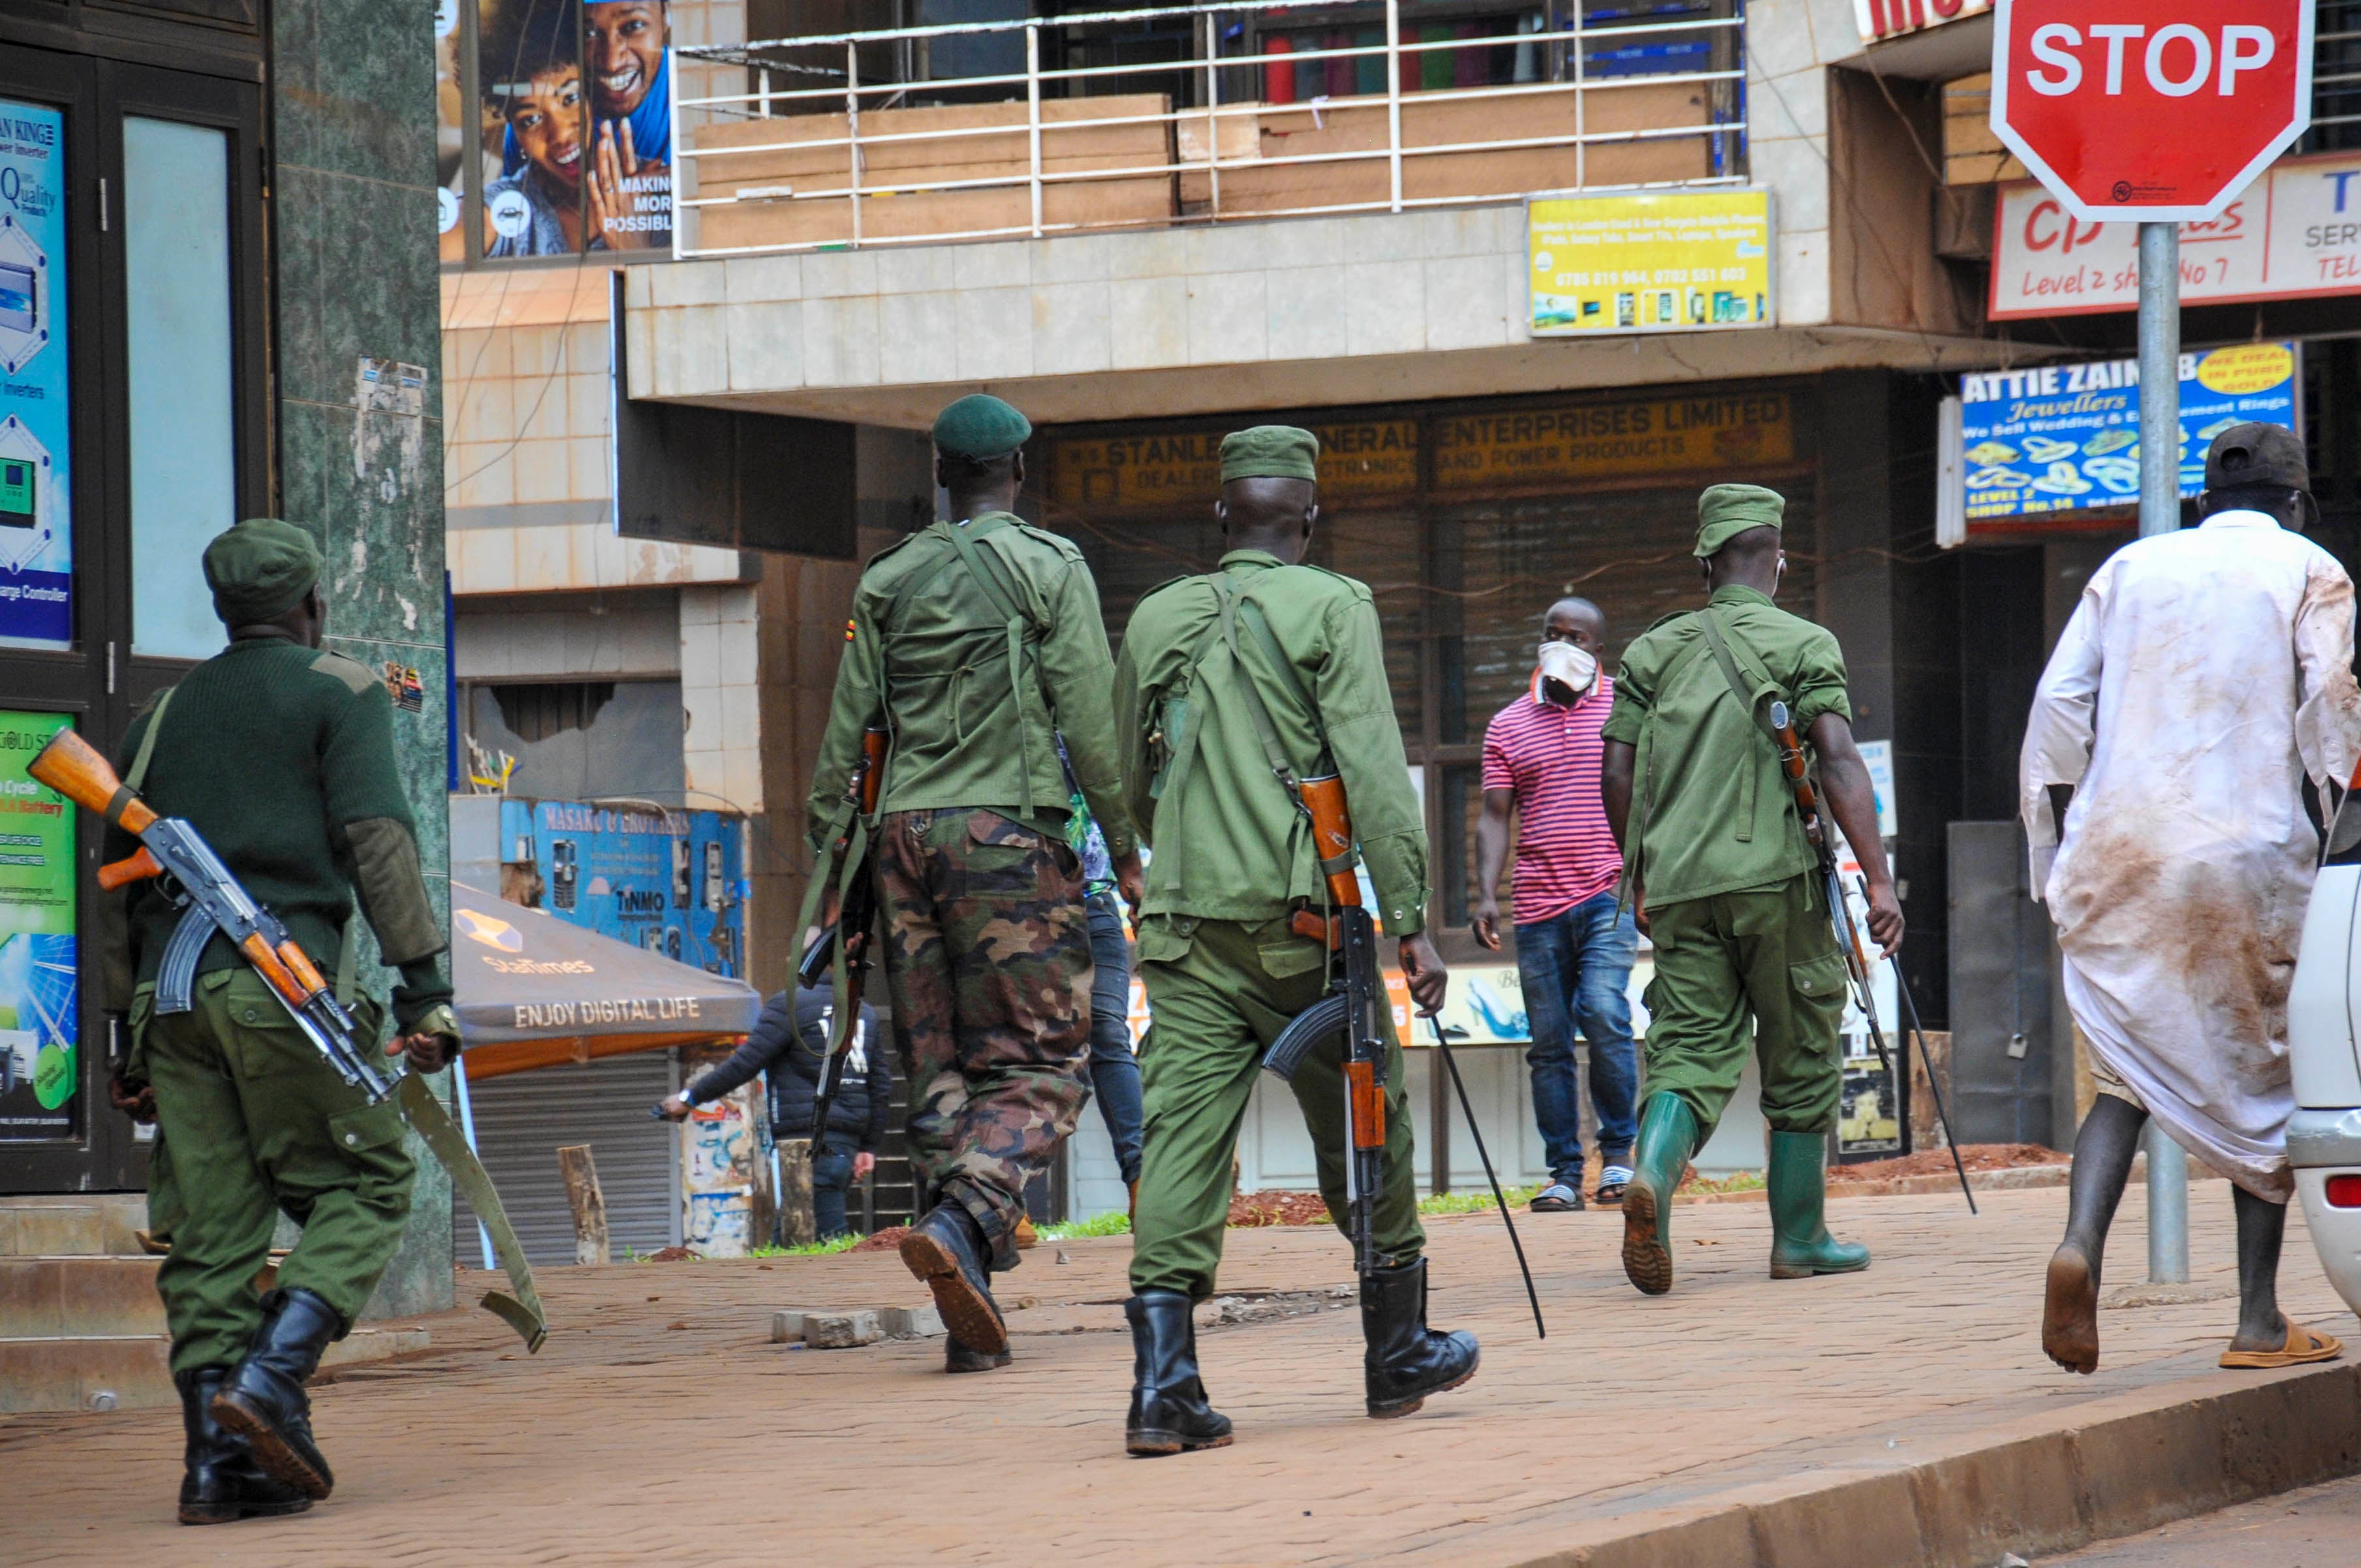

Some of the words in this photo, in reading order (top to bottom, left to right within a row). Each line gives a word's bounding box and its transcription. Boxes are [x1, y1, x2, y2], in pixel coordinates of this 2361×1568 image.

[2027, 23, 2275, 97] STOP
[1, 167, 55, 213] Quality
[619, 176, 672, 193] MAKIN
[634, 195, 672, 212] MOR
[603, 215, 672, 233] POSSIBL
[2306, 223, 2361, 247] SER
[2023, 264, 2085, 296] Level
[2092, 270, 2106, 289] 2
[2113, 262, 2140, 291] sh
[2216, 257, 2228, 283] 7
[1963, 366, 2060, 403] ATTIE
[2066, 353, 2197, 394] ZAINB
[1962, 427, 1989, 439] We
[1992, 422, 2025, 437] Sell
[2029, 414, 2105, 432] Wedding
[2238, 396, 2289, 413] Rings
[2007, 392, 2126, 423] Jewellers
[1106, 436, 1221, 469] STANLE
[1315, 426, 1418, 455] NERAL
[1439, 405, 1651, 448] ENTERPRISES
[1663, 396, 1783, 432] LIMITED
[1569, 435, 1684, 461] PRODUCTS
[0, 586, 20, 601] arge
[22, 584, 67, 602] Controller
[515, 1004, 576, 1028] ENJOY
[581, 999, 656, 1024] DIGITAL
[657, 996, 700, 1020] LIFE
